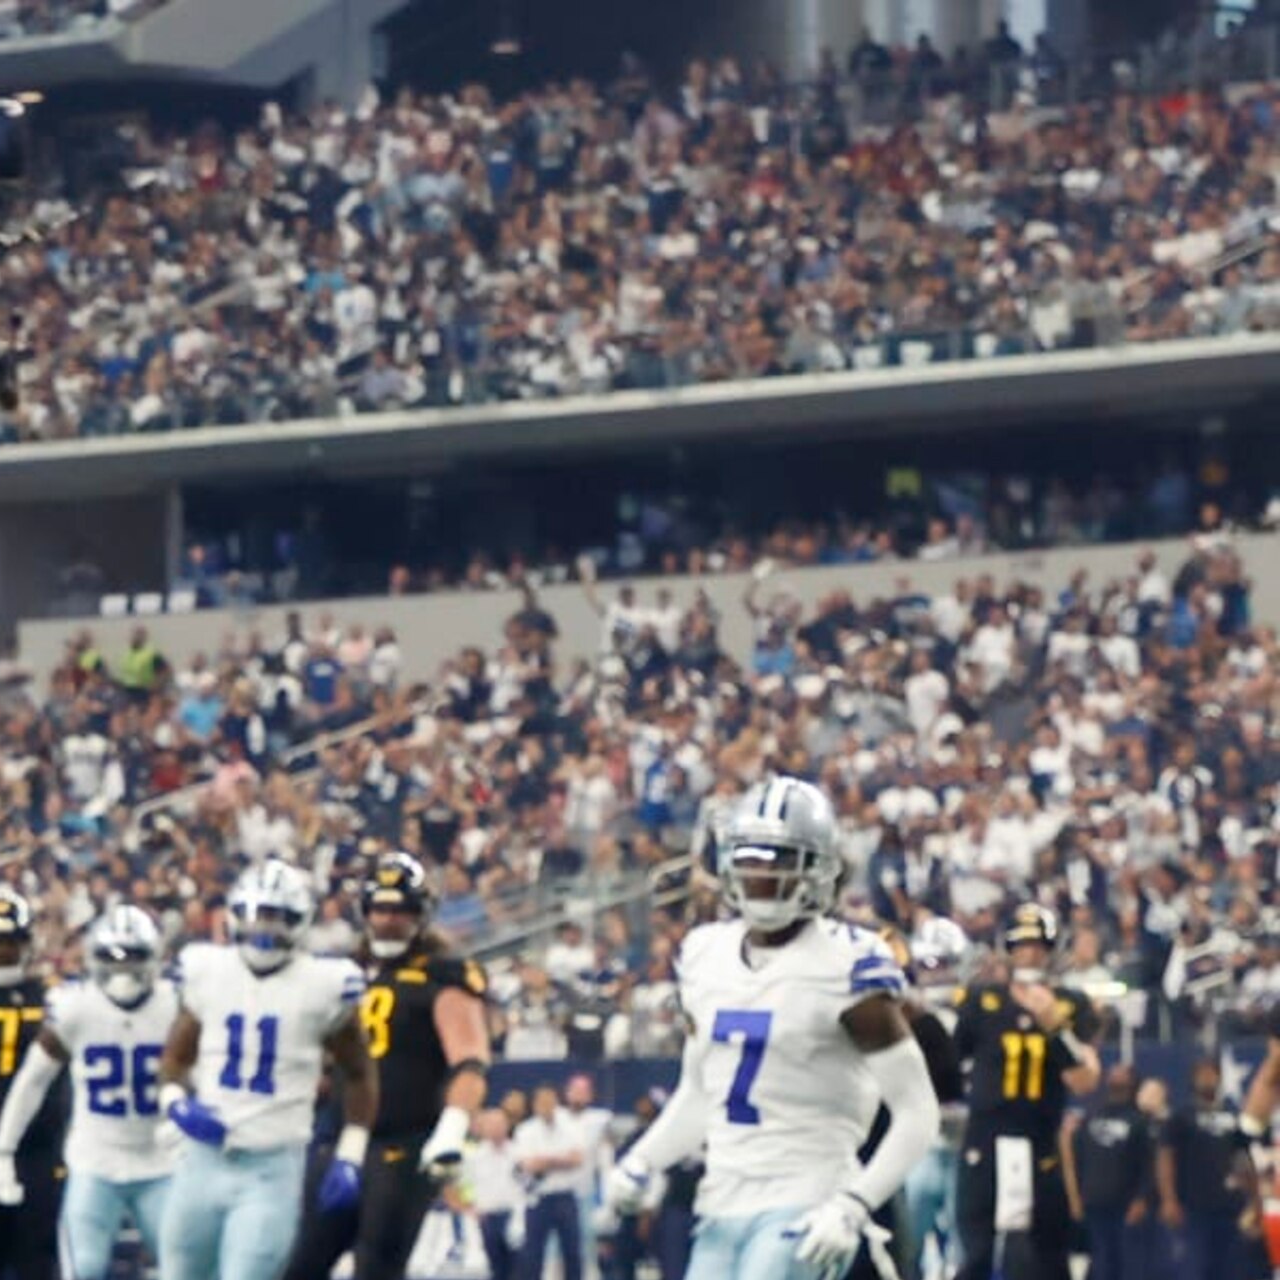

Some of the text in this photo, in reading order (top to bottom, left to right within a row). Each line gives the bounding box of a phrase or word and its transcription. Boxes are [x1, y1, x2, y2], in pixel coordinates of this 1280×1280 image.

[219, 1013, 278, 1095] 11
[711, 1010, 773, 1125] 7
[1002, 1033, 1045, 1099] 11
